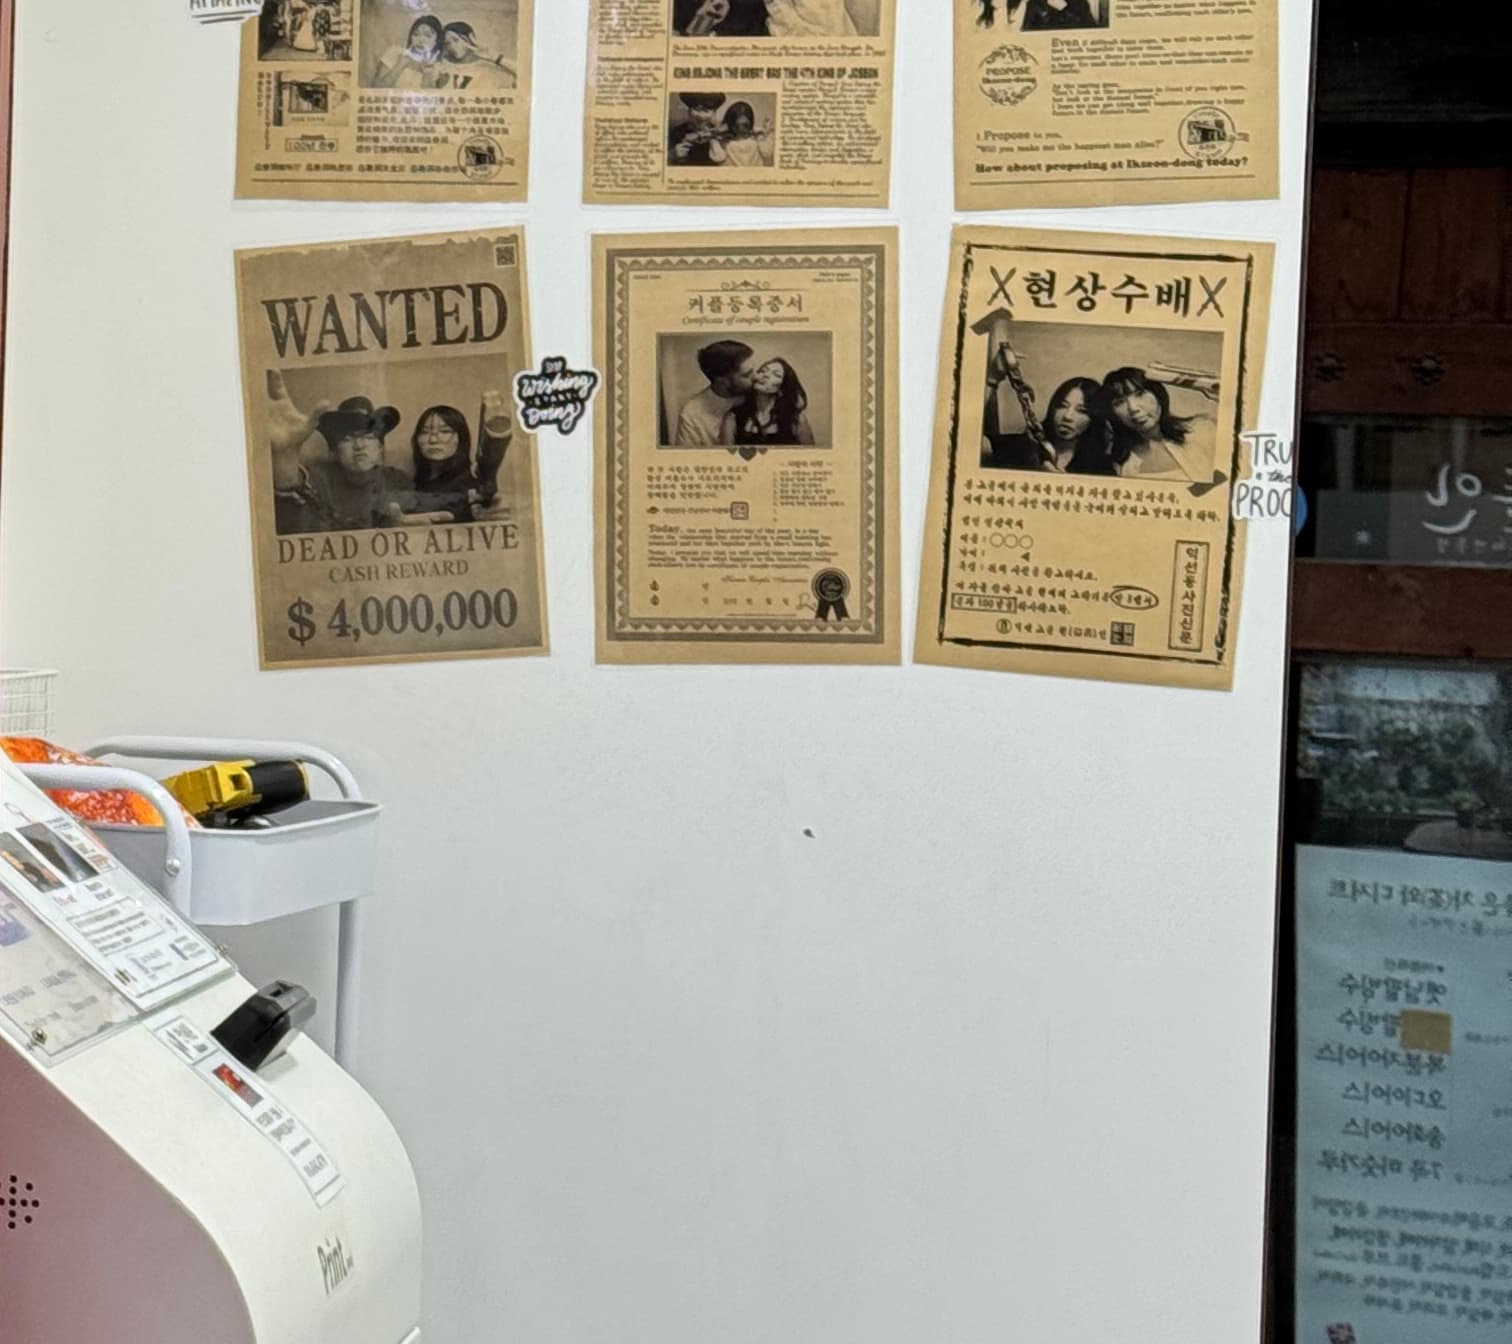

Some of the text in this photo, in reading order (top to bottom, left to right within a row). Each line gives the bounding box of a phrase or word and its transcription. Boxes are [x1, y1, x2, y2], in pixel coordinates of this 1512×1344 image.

[974, 154, 1248, 173] How about proposing at Ikseon-dong today?
[687, 292, 805, 315] 커플등록증서
[1022, 268, 1193, 318] 현상수배
[261, 281, 508, 358] WANTED
[276, 523, 520, 566] DEAD OR ALIVE
[325, 559, 469, 586] CASH REWARD
[287, 587, 518, 647] $ 4,000,000
